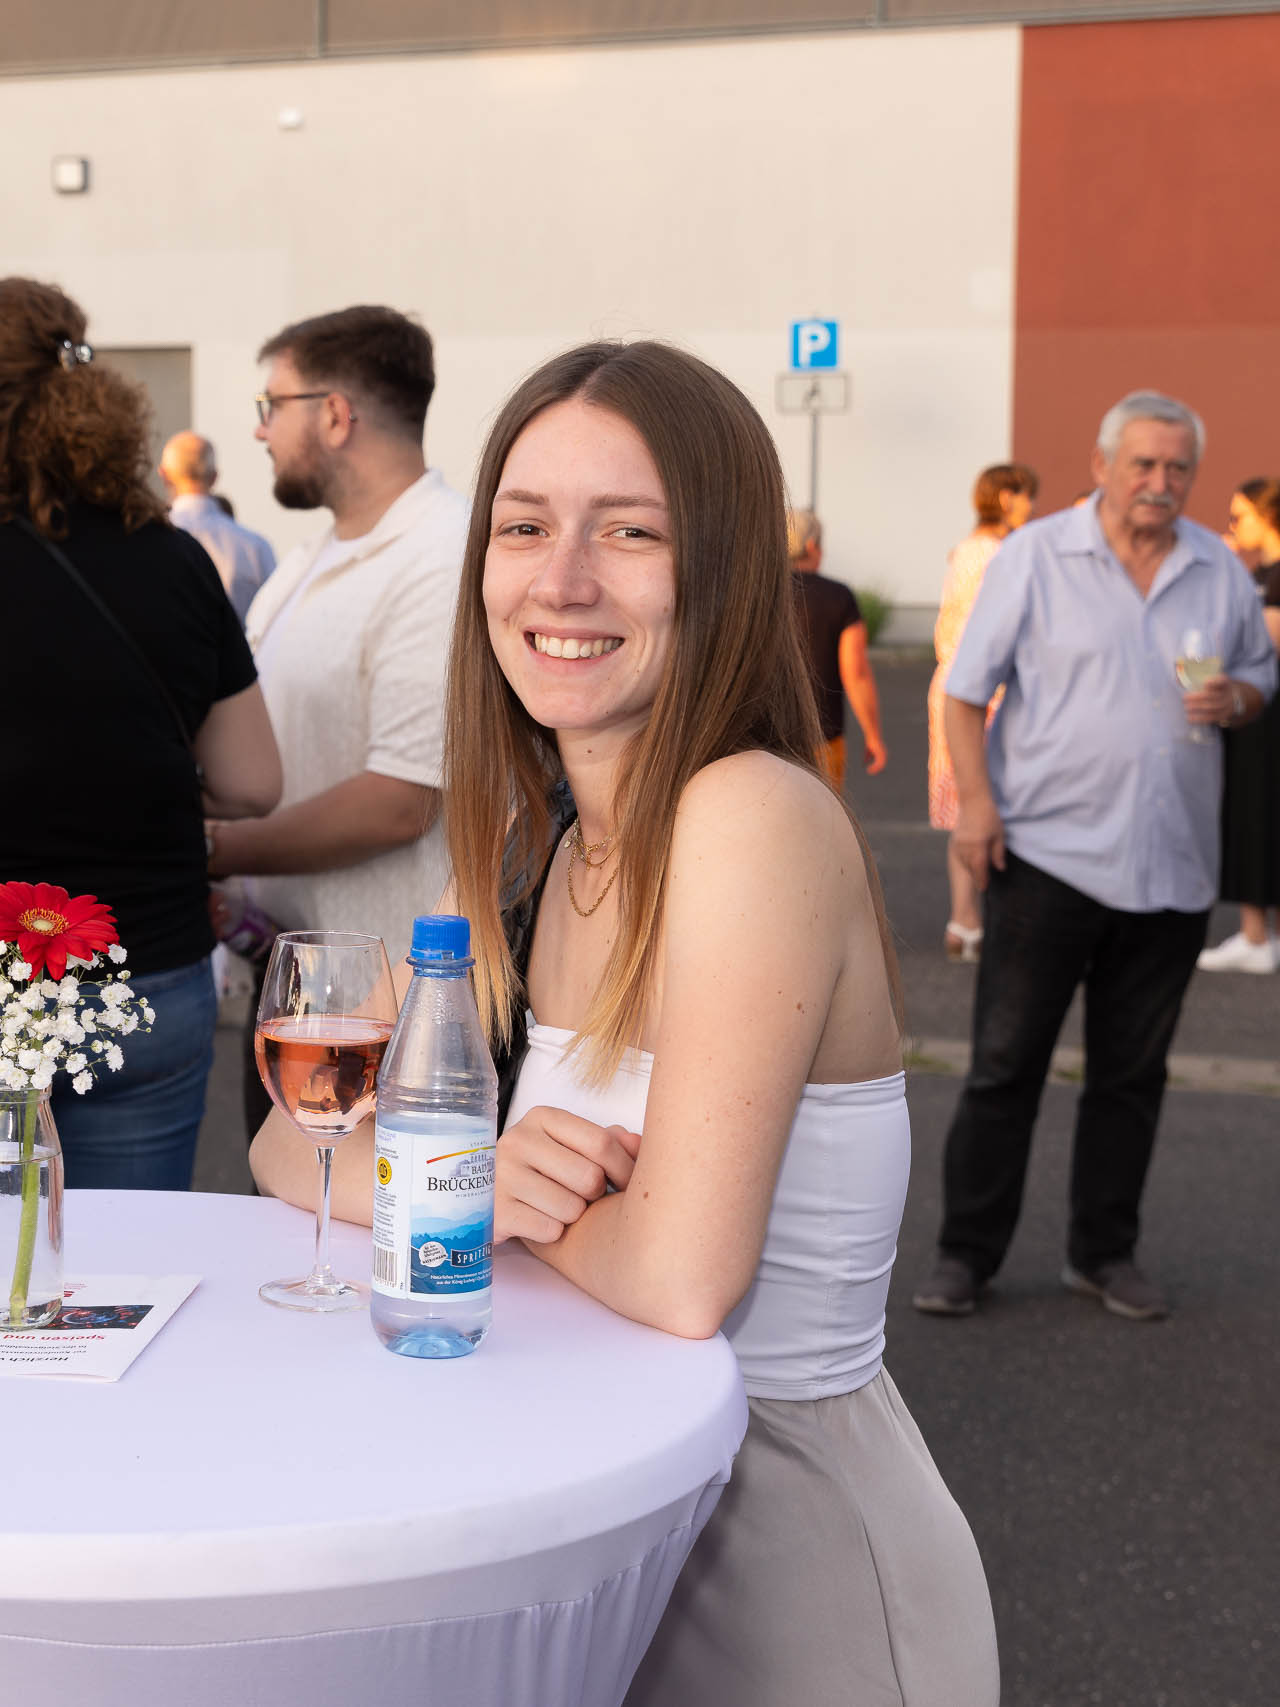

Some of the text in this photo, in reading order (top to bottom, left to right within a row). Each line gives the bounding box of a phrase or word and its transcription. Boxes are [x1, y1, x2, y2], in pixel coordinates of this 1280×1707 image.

[798, 323, 831, 368] P
[471, 1163, 488, 1175] BAD
[40, 1333, 105, 1341] Speisen
